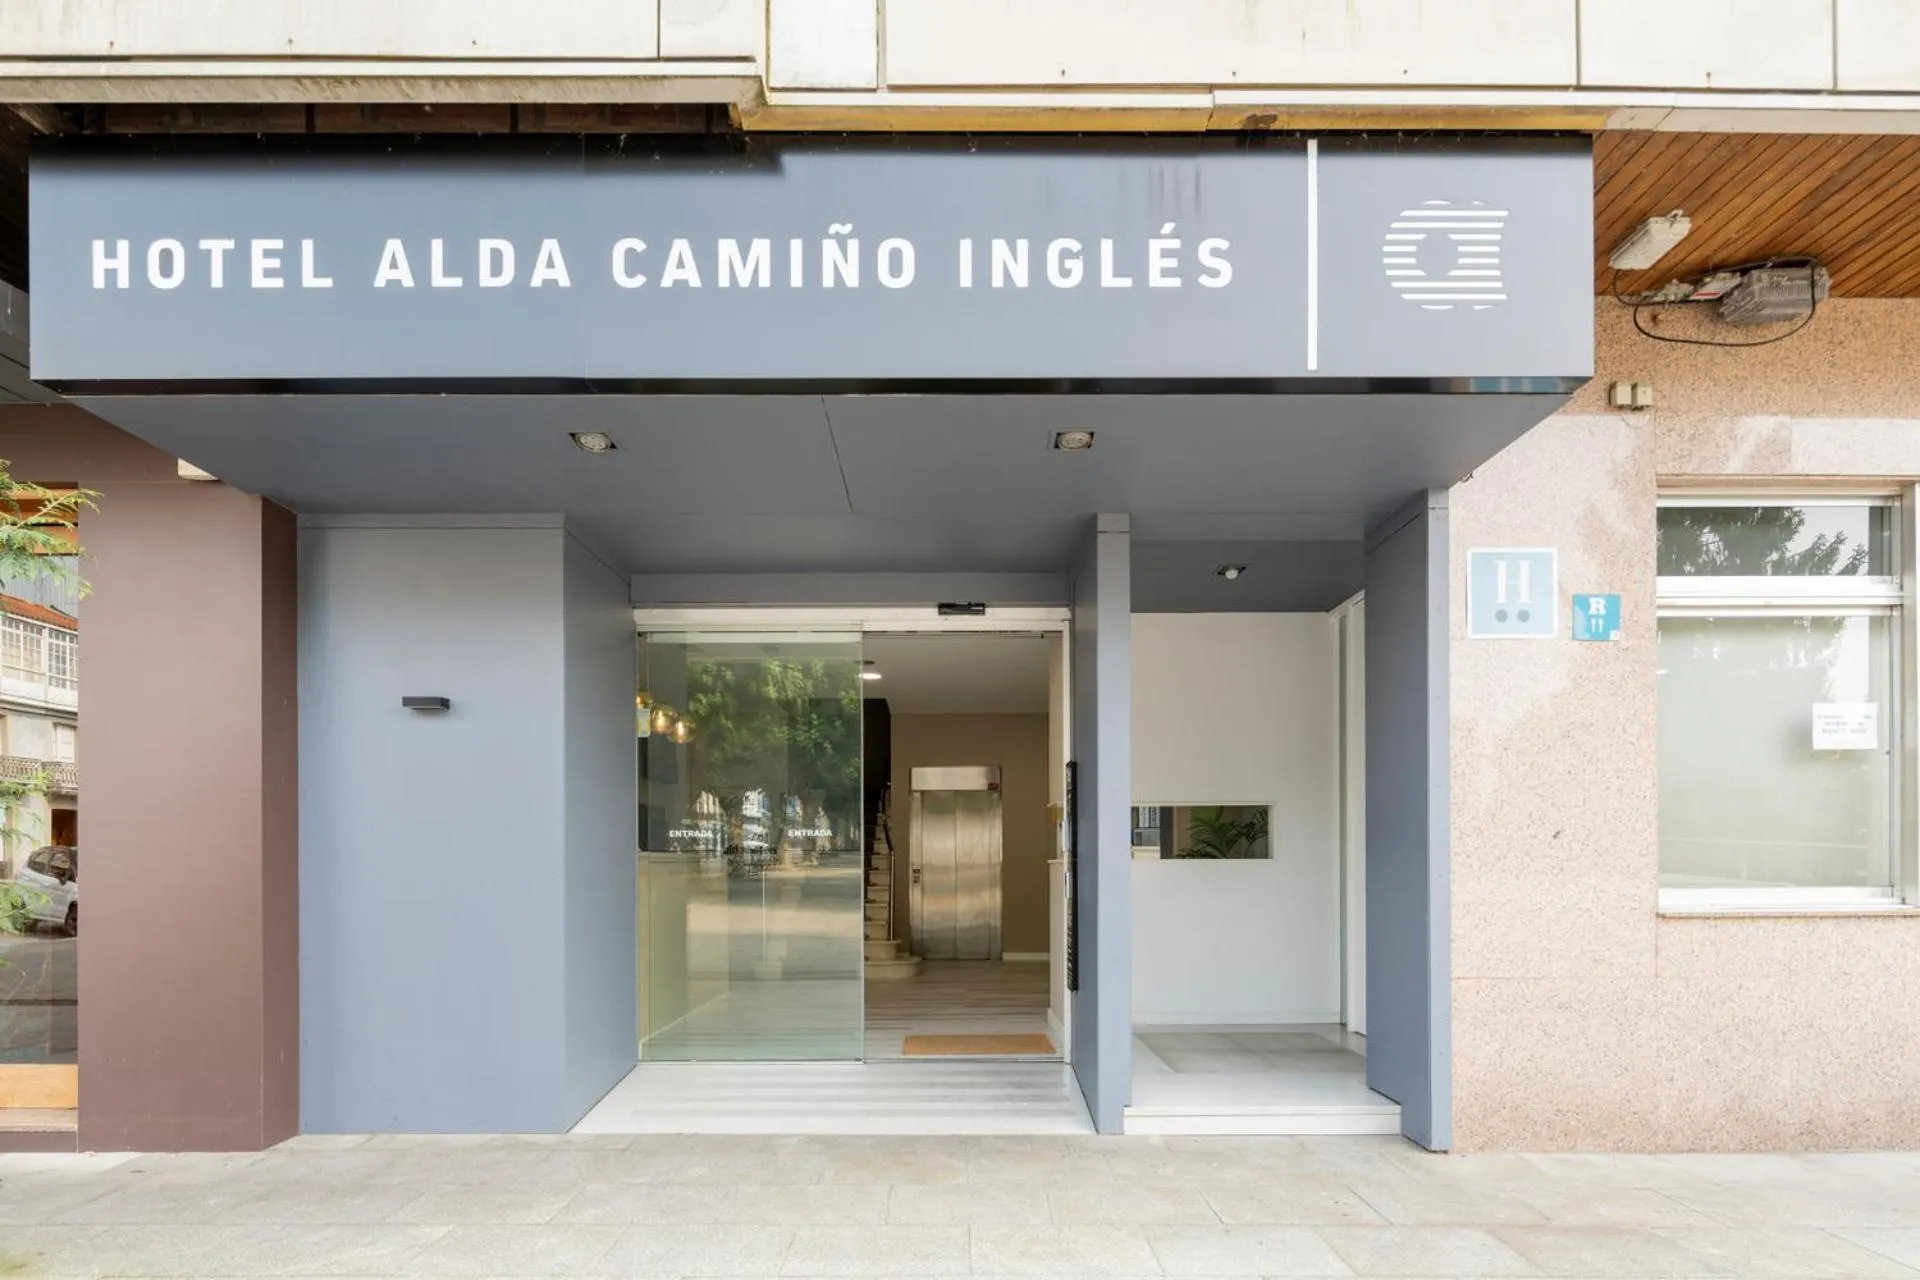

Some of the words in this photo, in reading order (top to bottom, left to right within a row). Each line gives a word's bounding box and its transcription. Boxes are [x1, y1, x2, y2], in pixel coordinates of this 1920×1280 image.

[91, 238, 333, 290] HOTEL
[373, 238, 571, 289] ALDA
[611, 222, 917, 290] CAMIÑO
[958, 221, 1234, 290] INGLÉS
[1495, 560, 1533, 604] H
[1588, 596, 1607, 616] R
[669, 829, 713, 838] ENTRADA
[788, 828, 833, 837] ENTRADA
